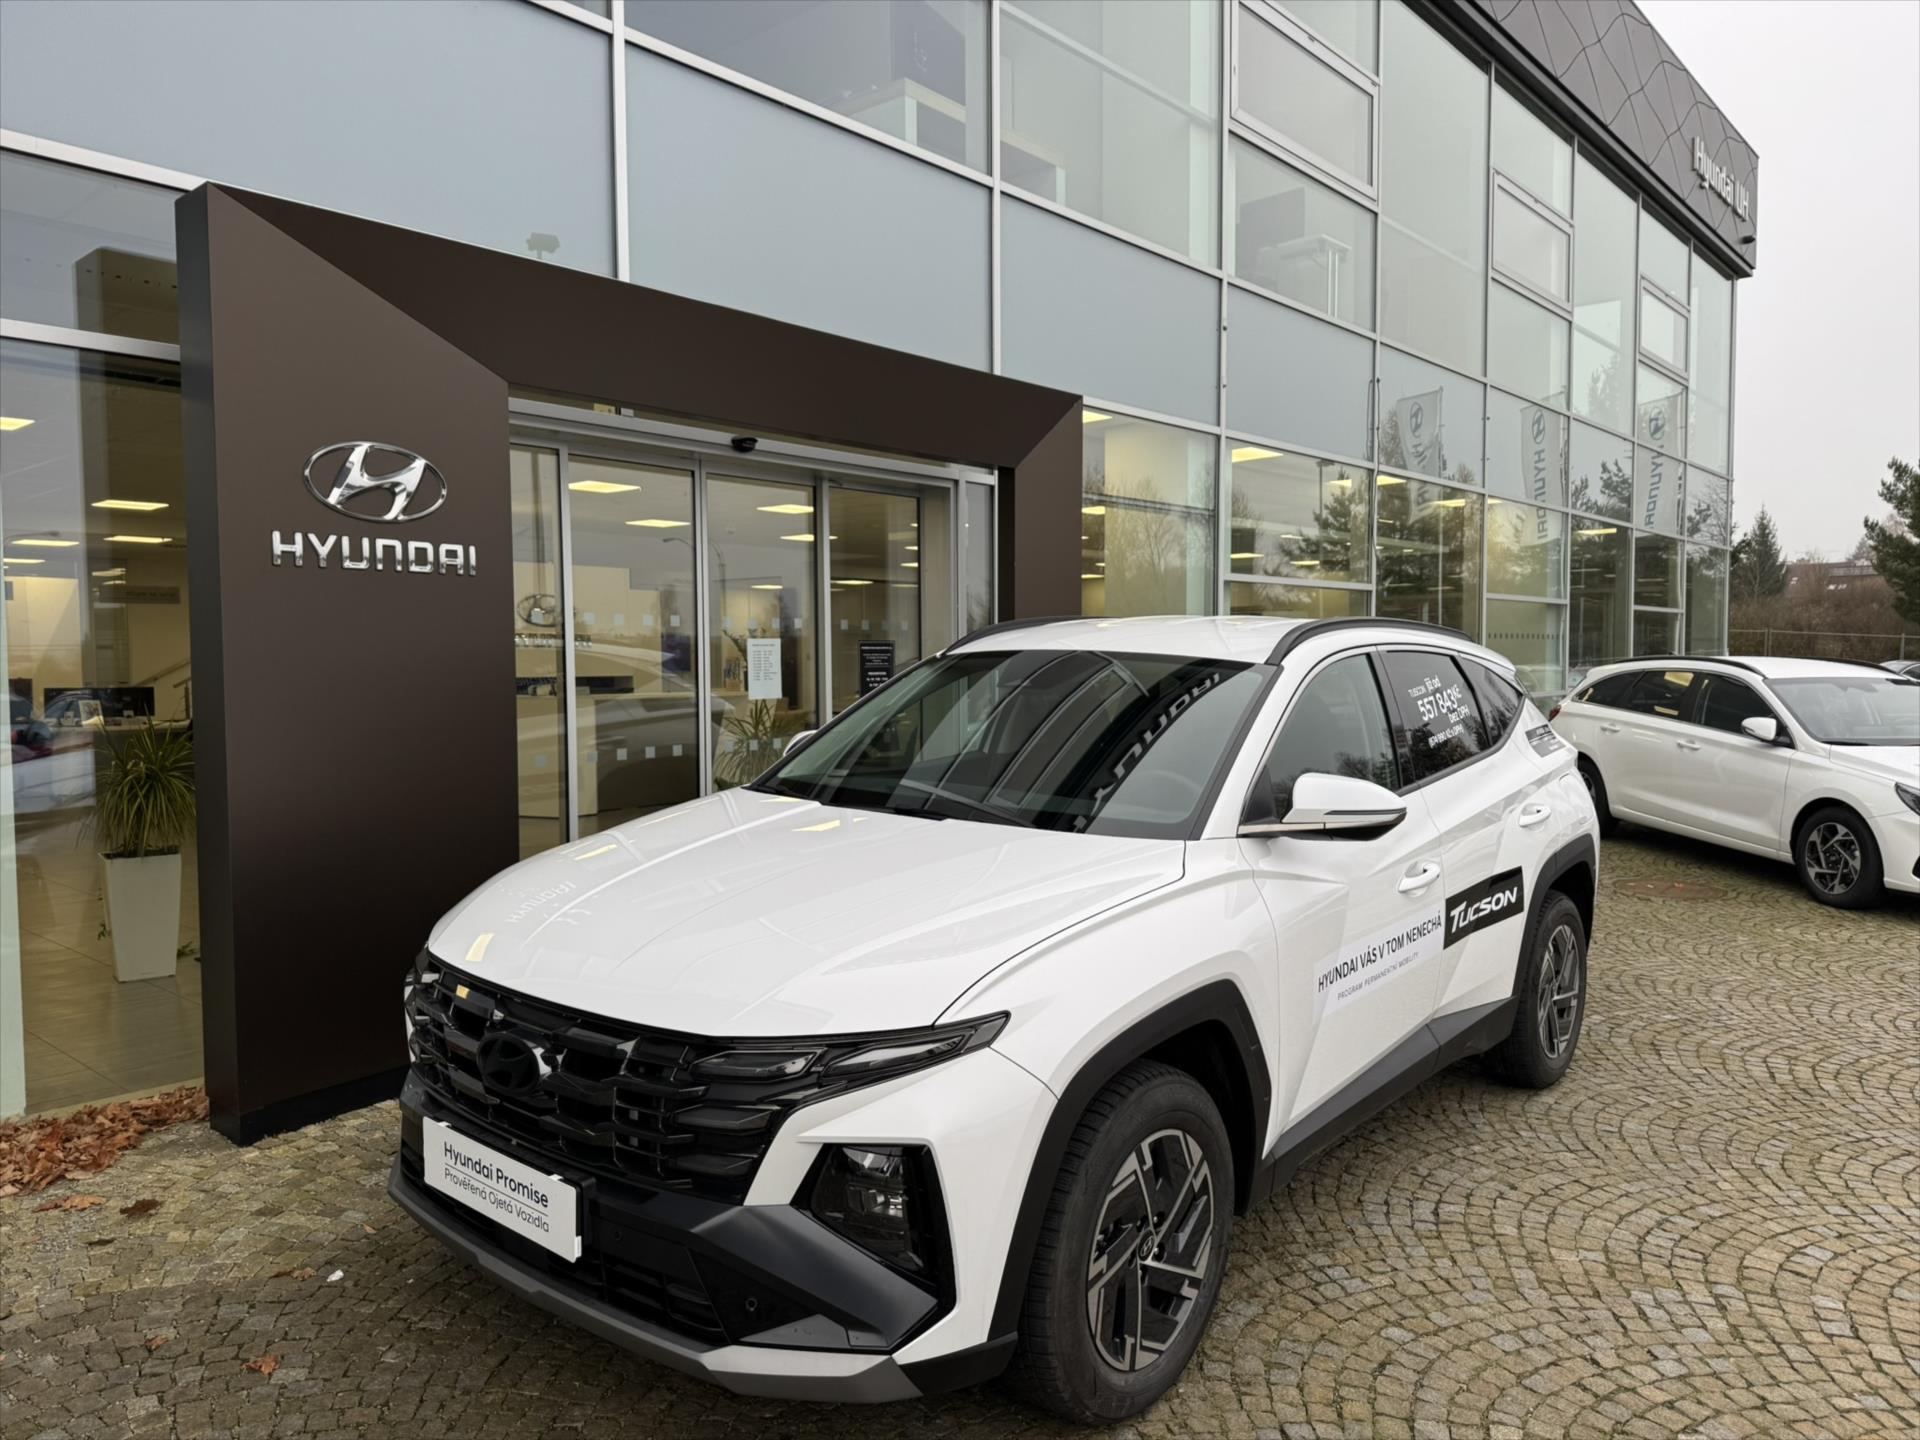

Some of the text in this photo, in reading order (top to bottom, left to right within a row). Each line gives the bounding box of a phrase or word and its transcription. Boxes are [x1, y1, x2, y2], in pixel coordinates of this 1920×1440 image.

[1693, 136, 1734, 206] Hyundai
[272, 530, 477, 576] HYUNDAI
[1417, 695, 1438, 721] 557
[1435, 688, 1458, 714] 843
[1456, 703, 1471, 719] DPH
[1450, 886, 1518, 933] TUCSON
[1318, 910, 1442, 993] HYUNDAI VÁS V TOM NENECHÁ
[1337, 981, 1363, 1001] PROGRAM
[444, 1141, 549, 1208] Hyundai Promise
[444, 1168, 550, 1233] Prověřená Ojetá Vozidla
